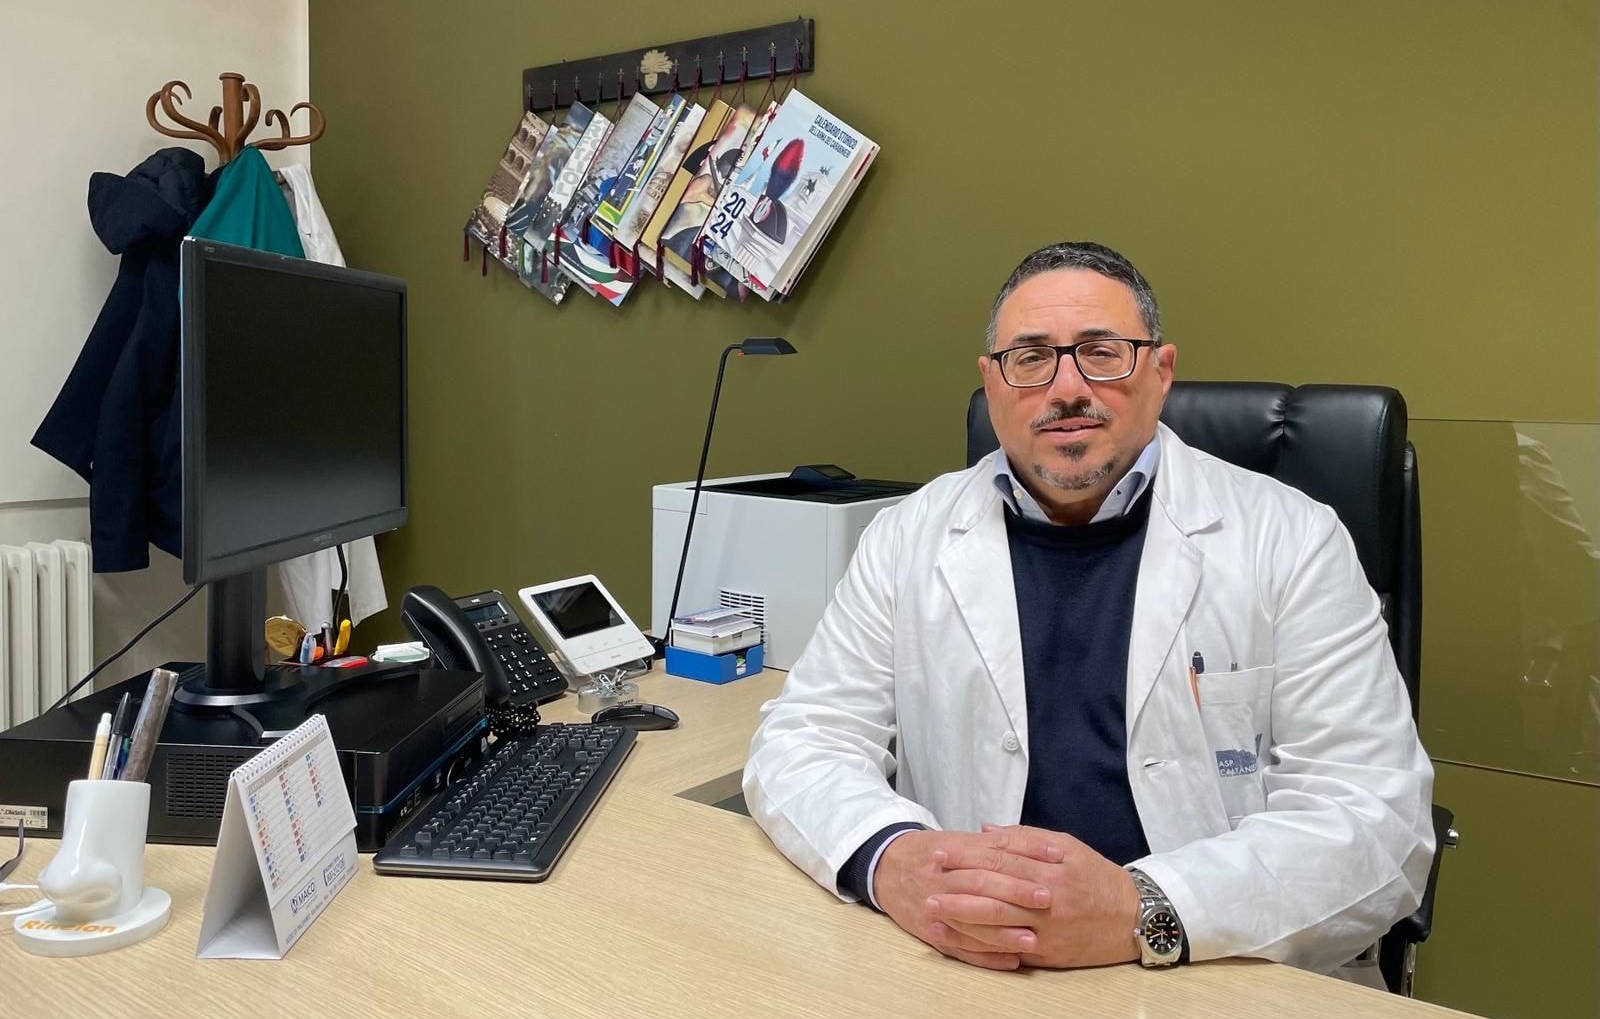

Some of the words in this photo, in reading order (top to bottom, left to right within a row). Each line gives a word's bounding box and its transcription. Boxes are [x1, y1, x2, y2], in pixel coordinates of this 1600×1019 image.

[814, 114, 841, 138] CALENDARIO
[837, 130, 858, 150] STORICO
[723, 192, 747, 219] 20
[710, 212, 734, 239] 24
[1219, 759, 1234, 768] ASP
